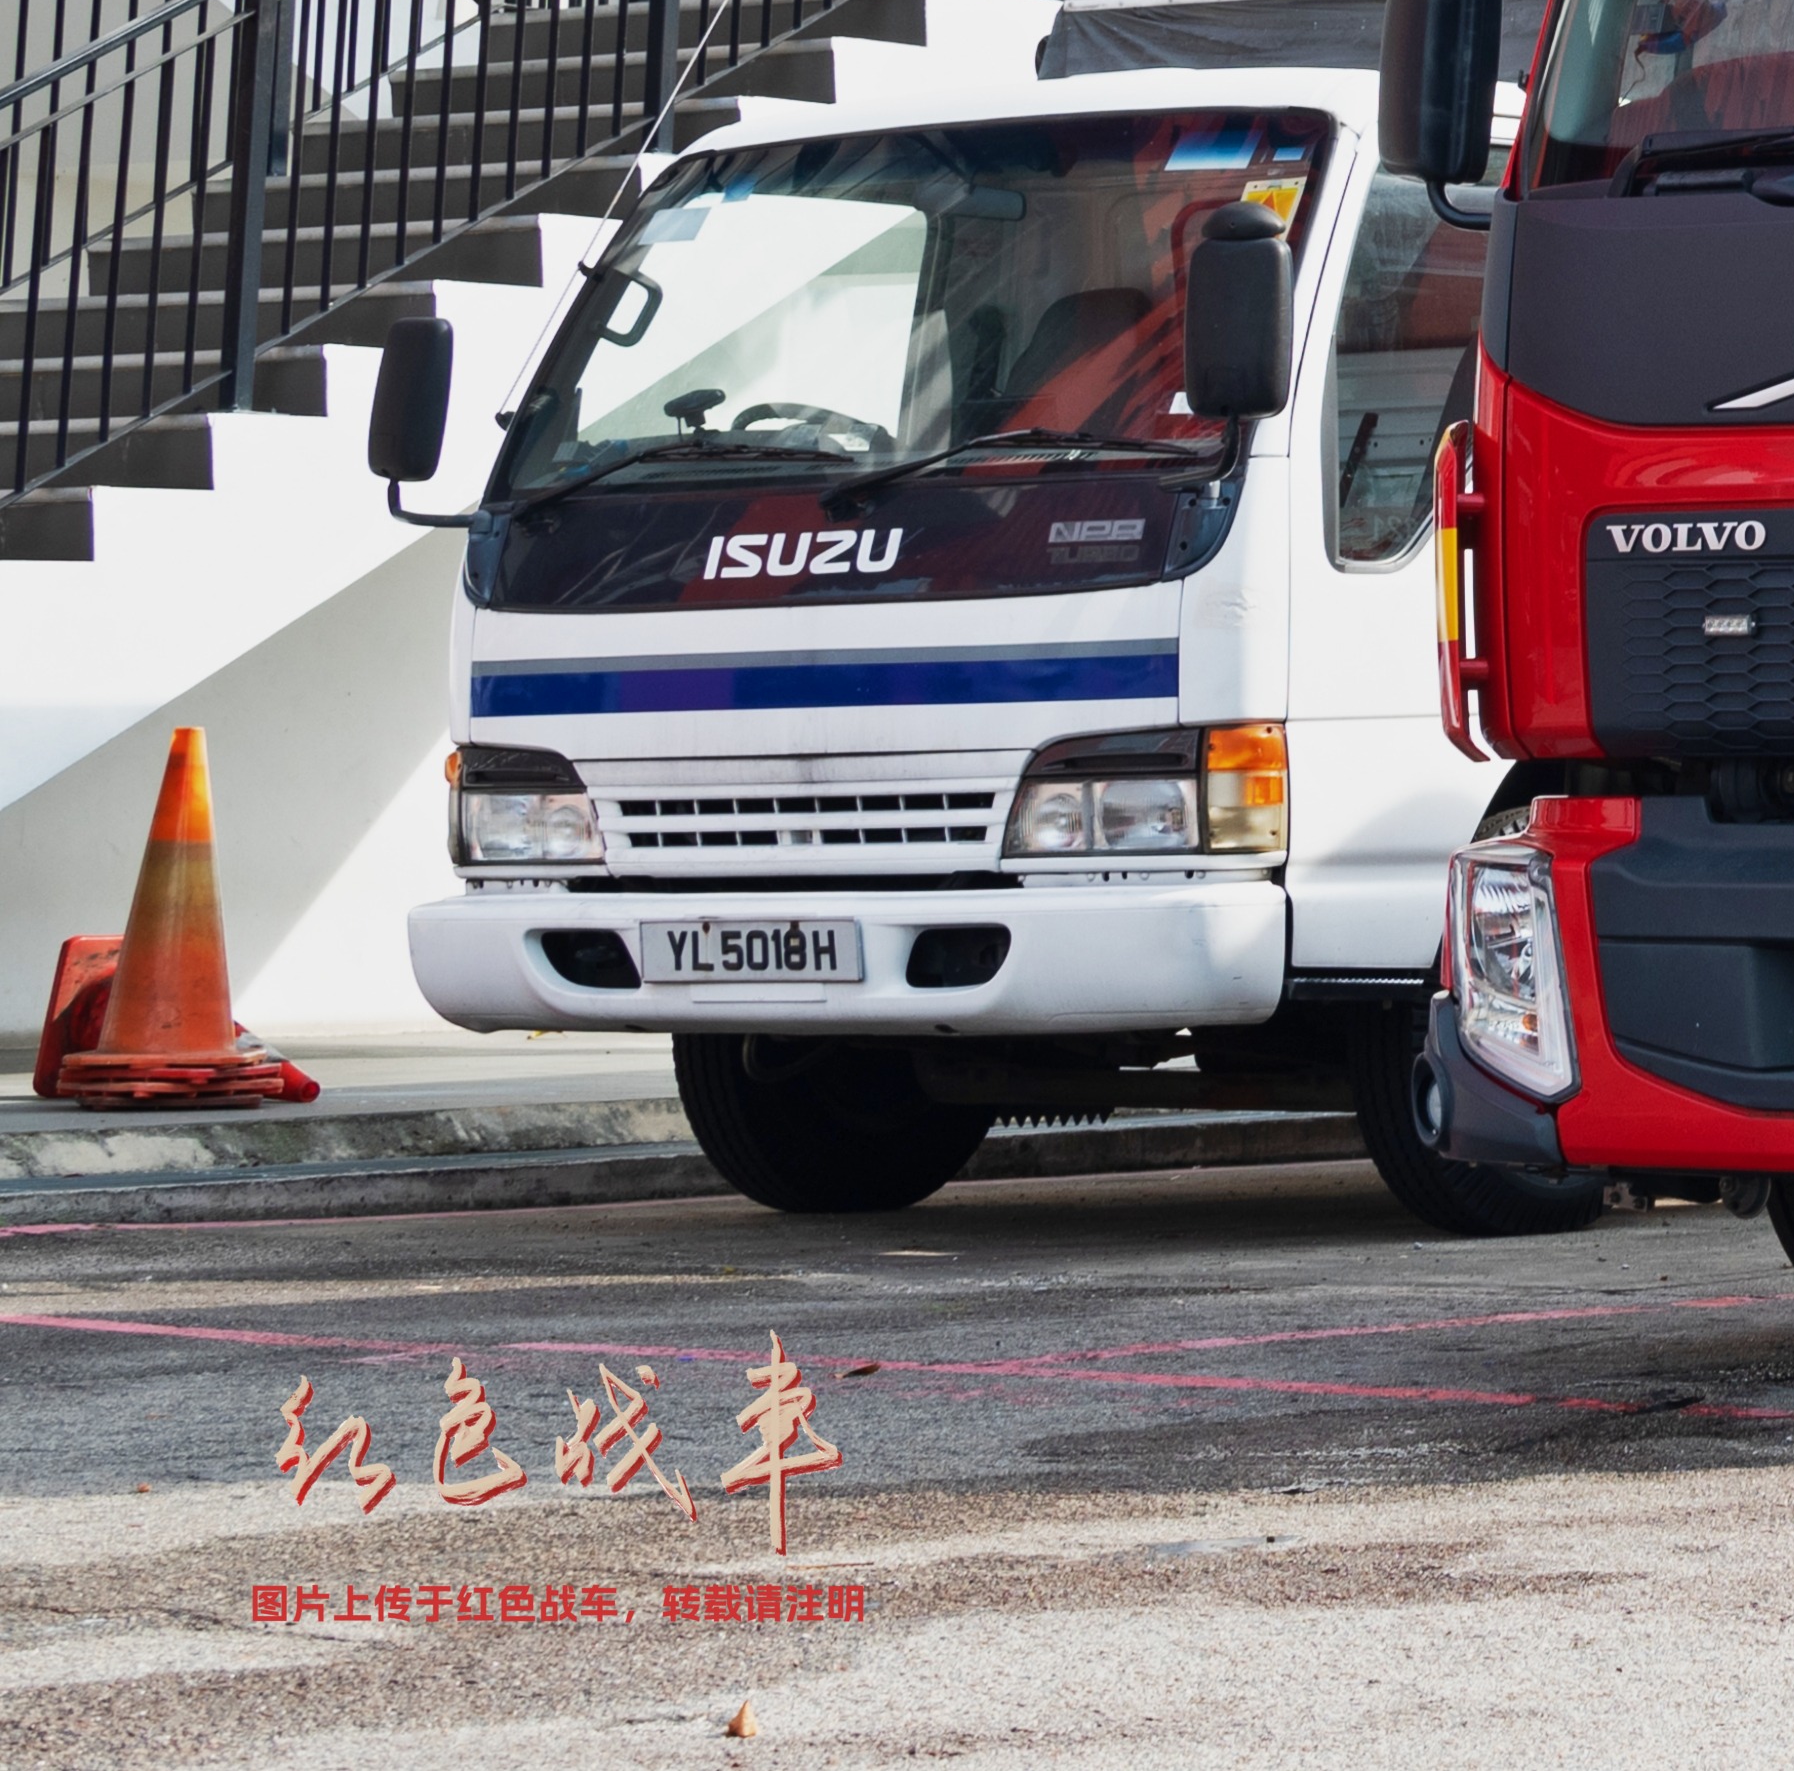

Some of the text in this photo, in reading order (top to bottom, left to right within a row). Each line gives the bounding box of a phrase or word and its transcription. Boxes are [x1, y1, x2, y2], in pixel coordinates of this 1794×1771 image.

[1048, 518, 1146, 543] NPR
[1606, 520, 1766, 553] VOLVO
[703, 527, 904, 580] ISUZU
[667, 928, 837, 971] YL5018H
